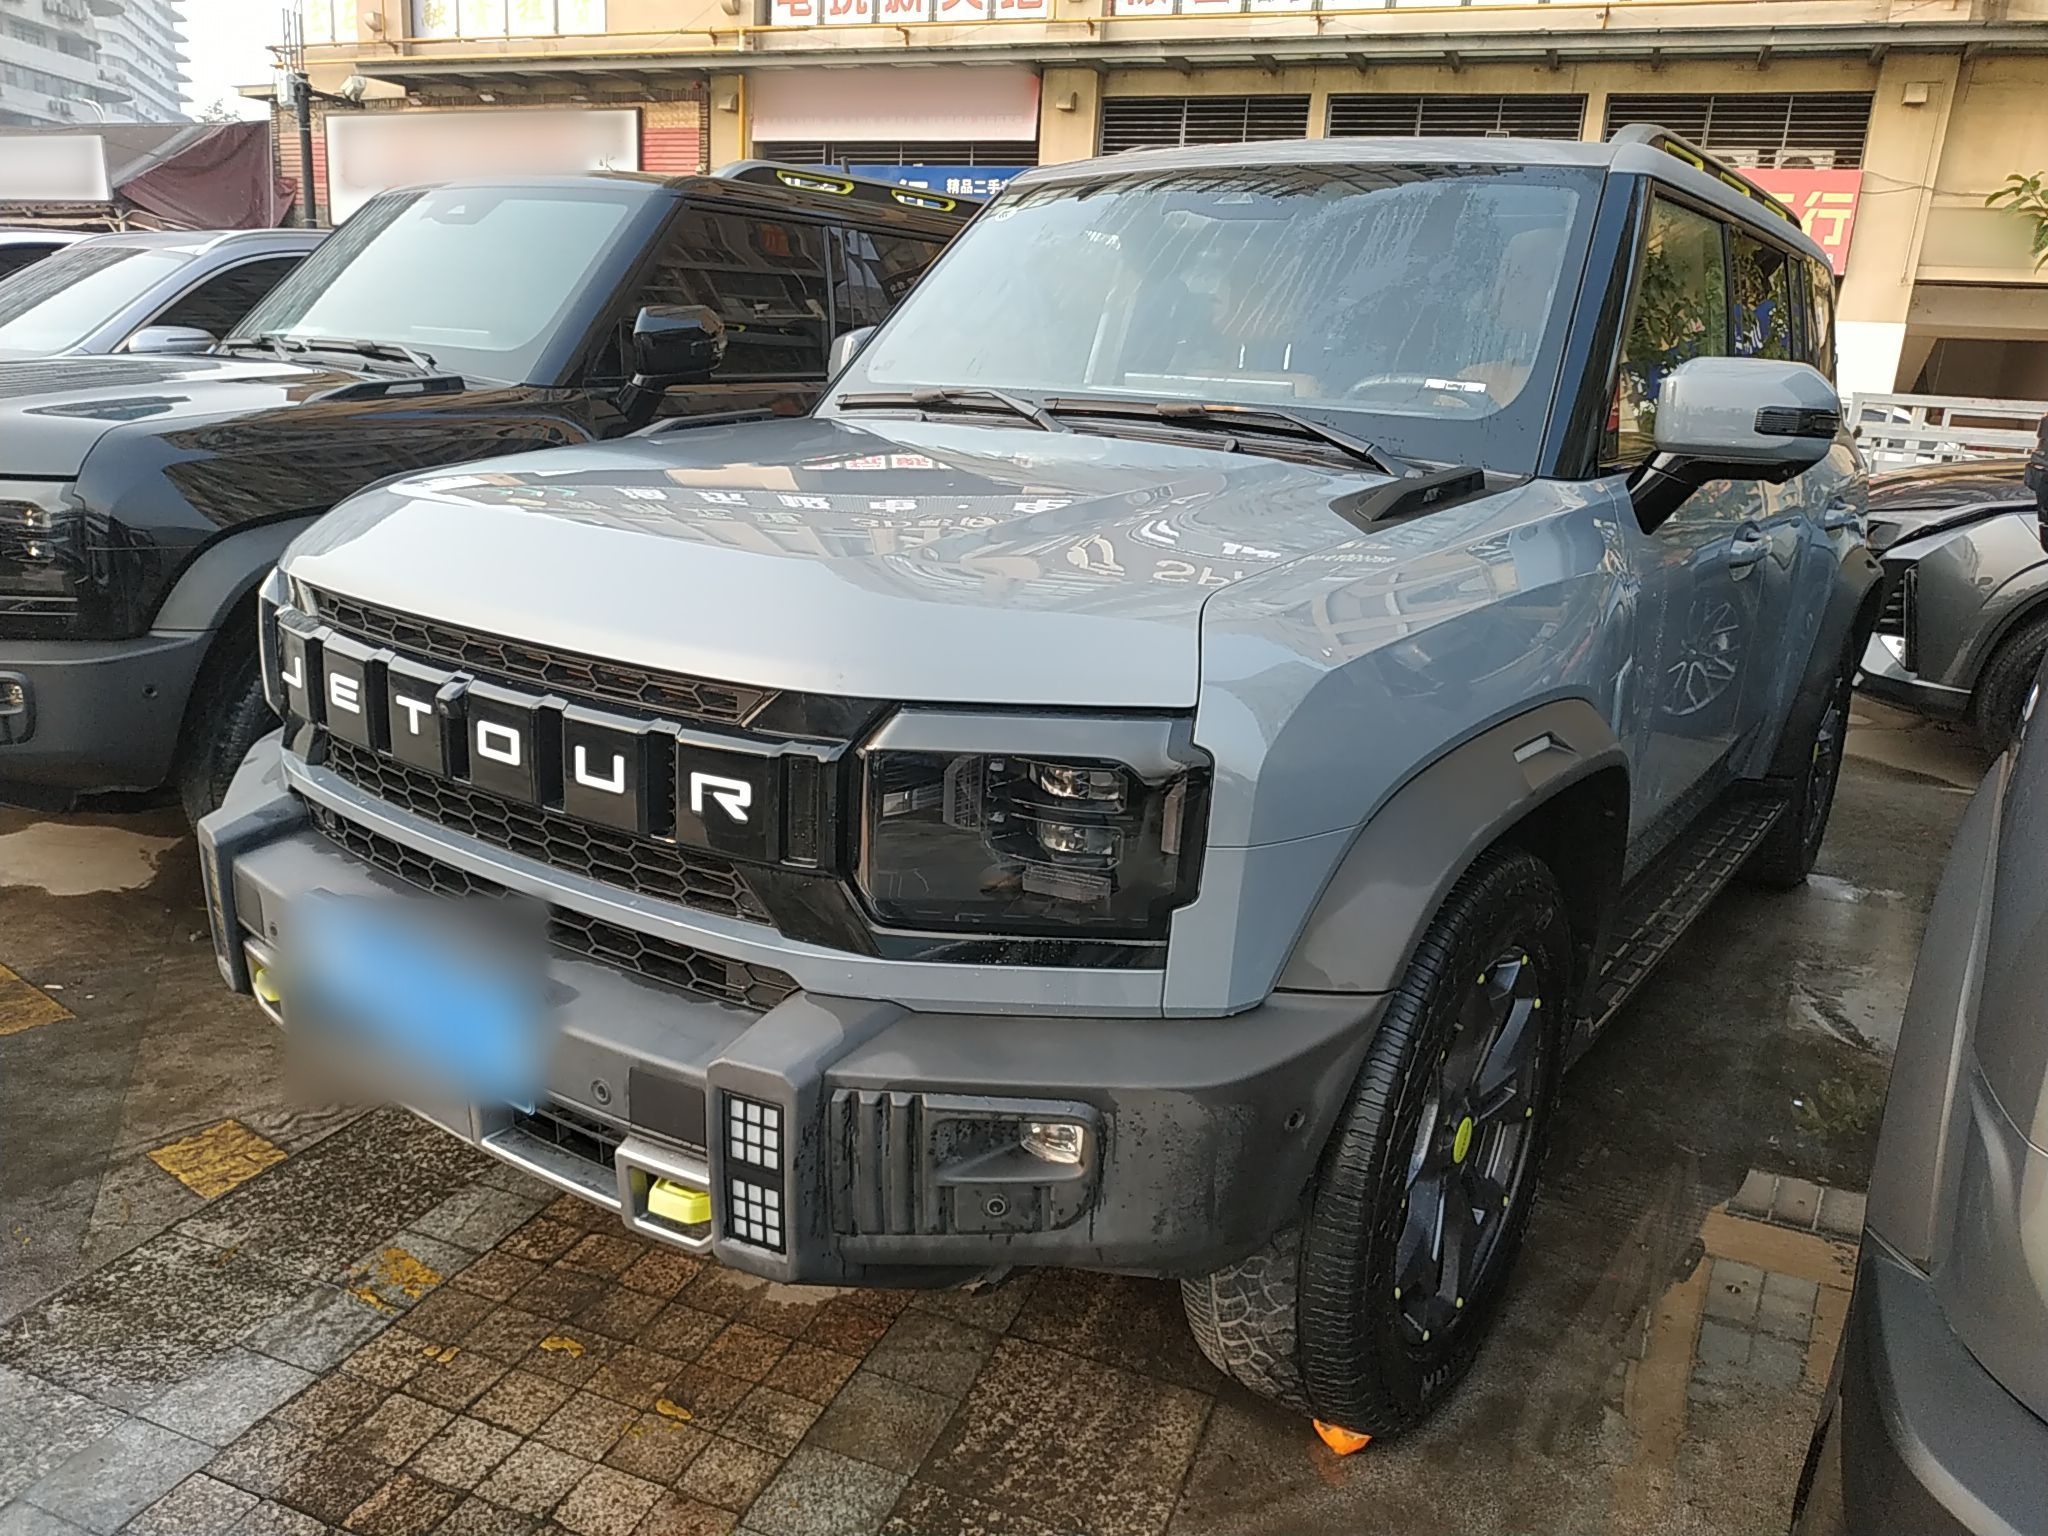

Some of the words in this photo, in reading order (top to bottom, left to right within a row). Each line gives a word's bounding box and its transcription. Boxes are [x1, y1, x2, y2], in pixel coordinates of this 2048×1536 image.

[946, 178, 1008, 195] 精品二手
[282, 656, 752, 824] JETOUR
